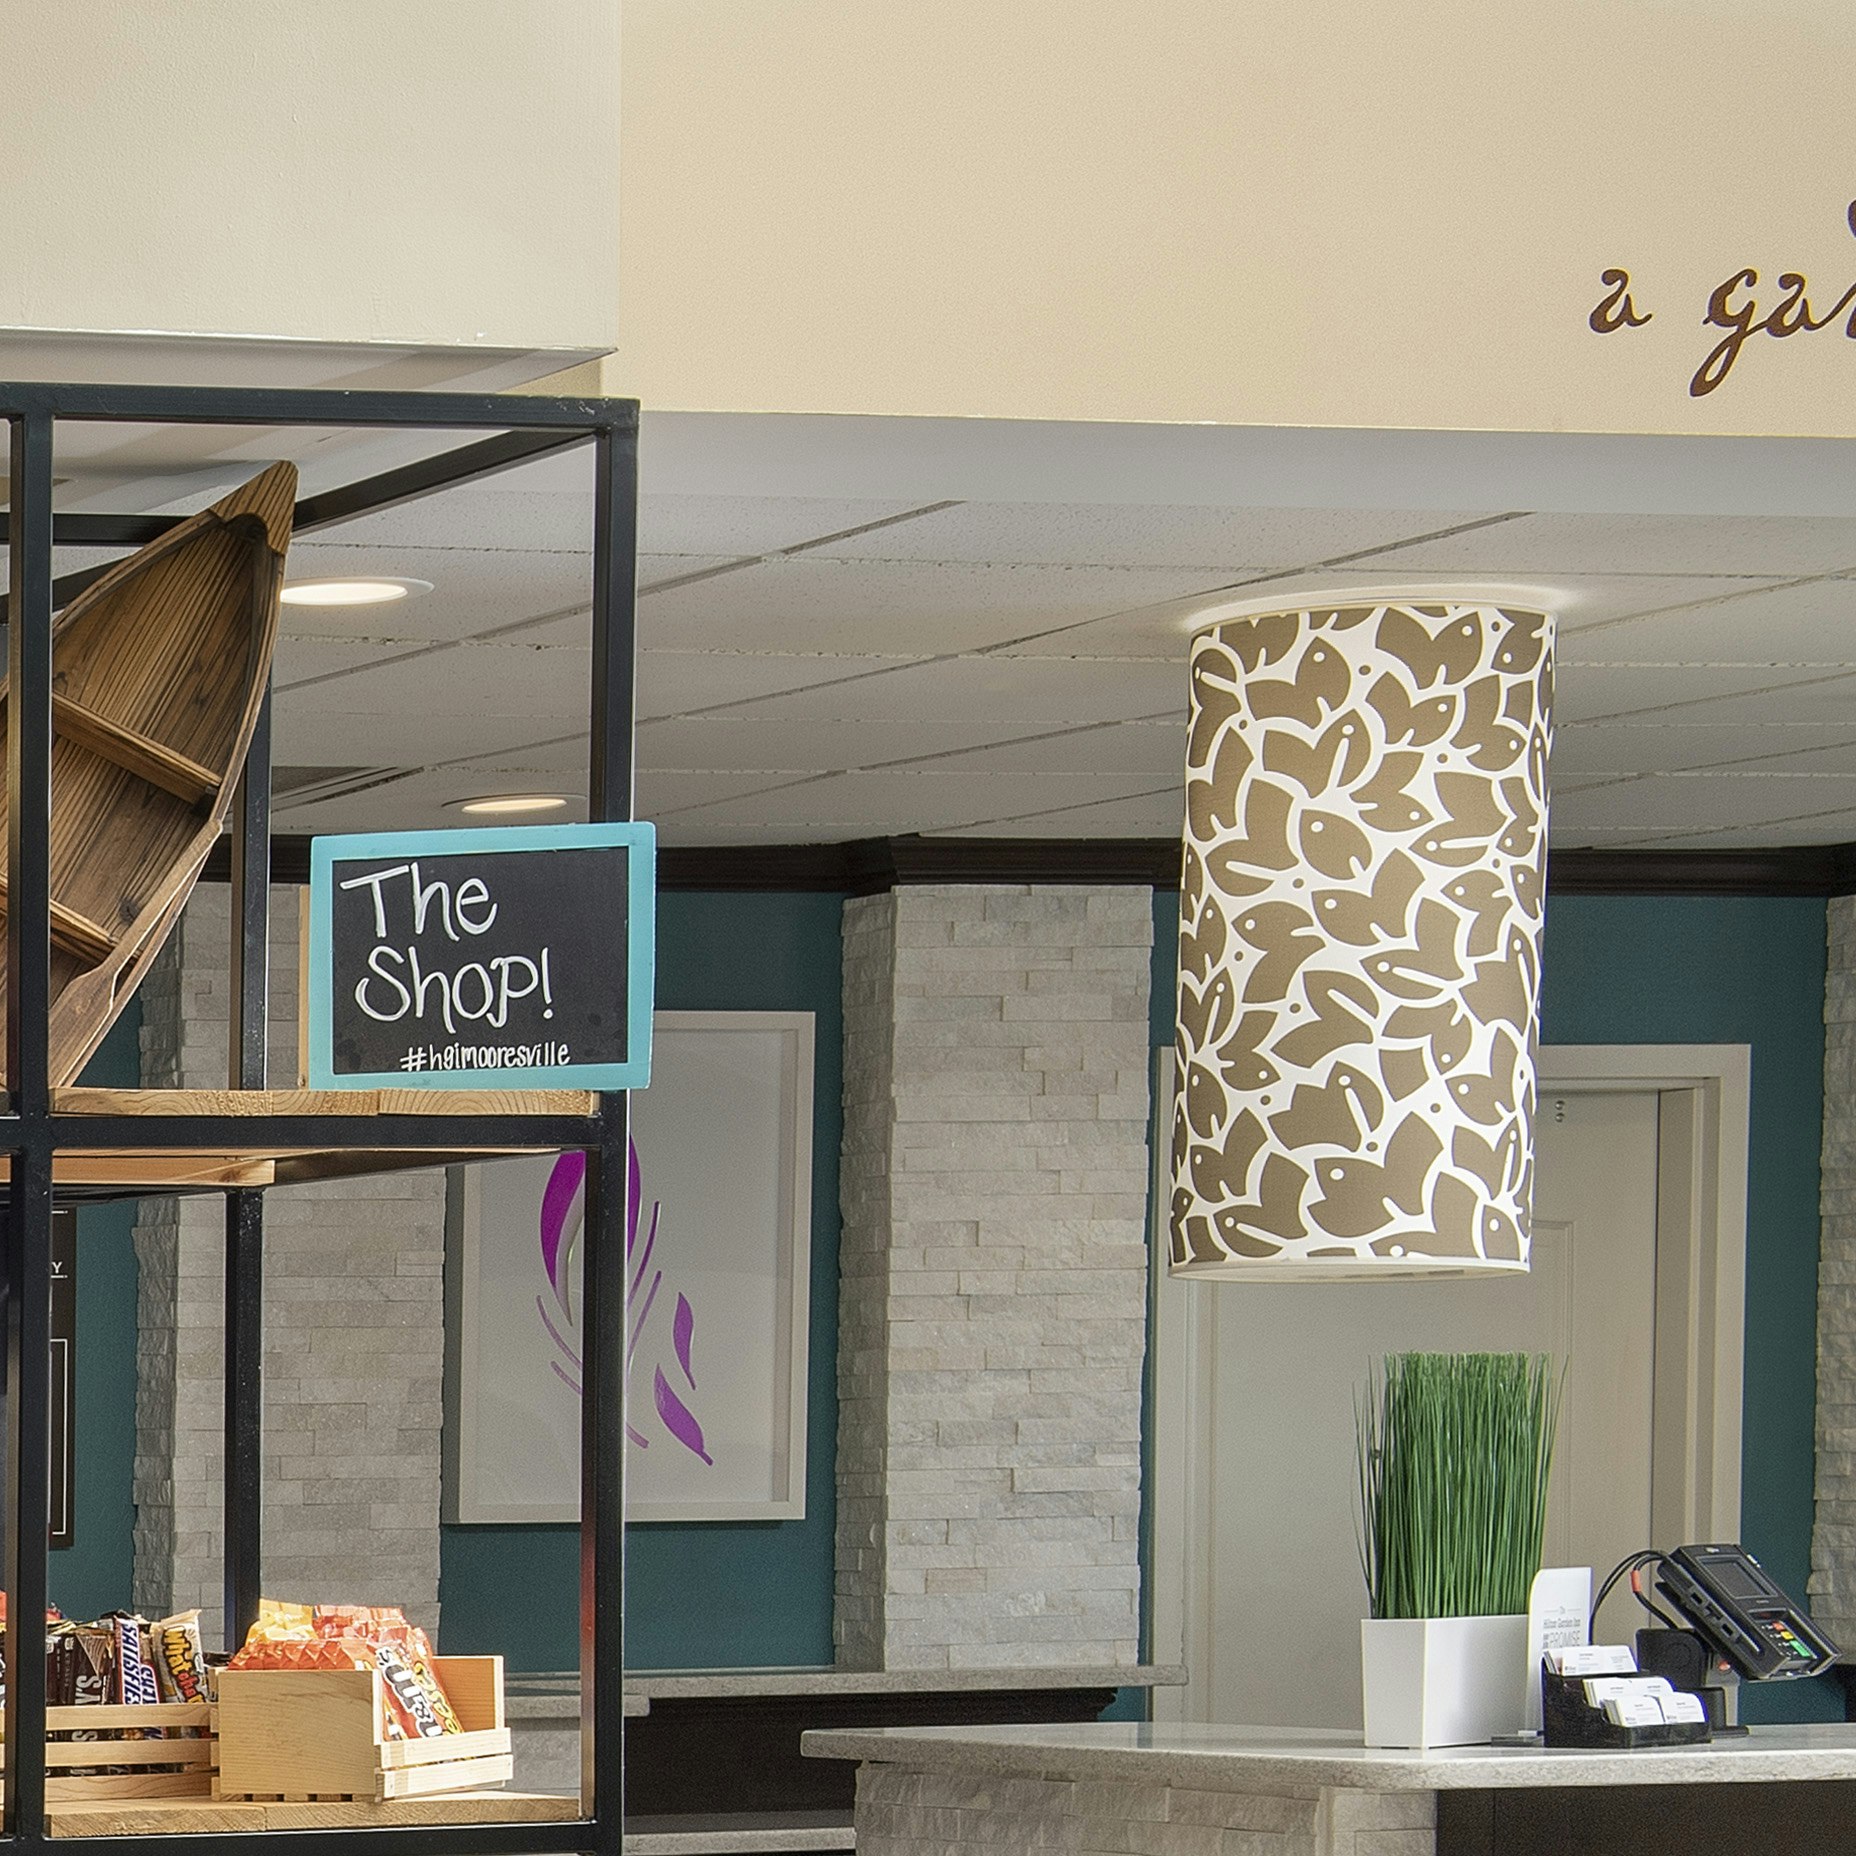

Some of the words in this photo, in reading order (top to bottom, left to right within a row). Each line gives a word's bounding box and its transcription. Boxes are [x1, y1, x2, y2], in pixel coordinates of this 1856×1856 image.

[1589, 268, 1652, 334] a
[339, 862, 498, 942] The
[354, 945, 553, 1034] Shop!
[400, 1041, 571, 1072] #hgimooresville
